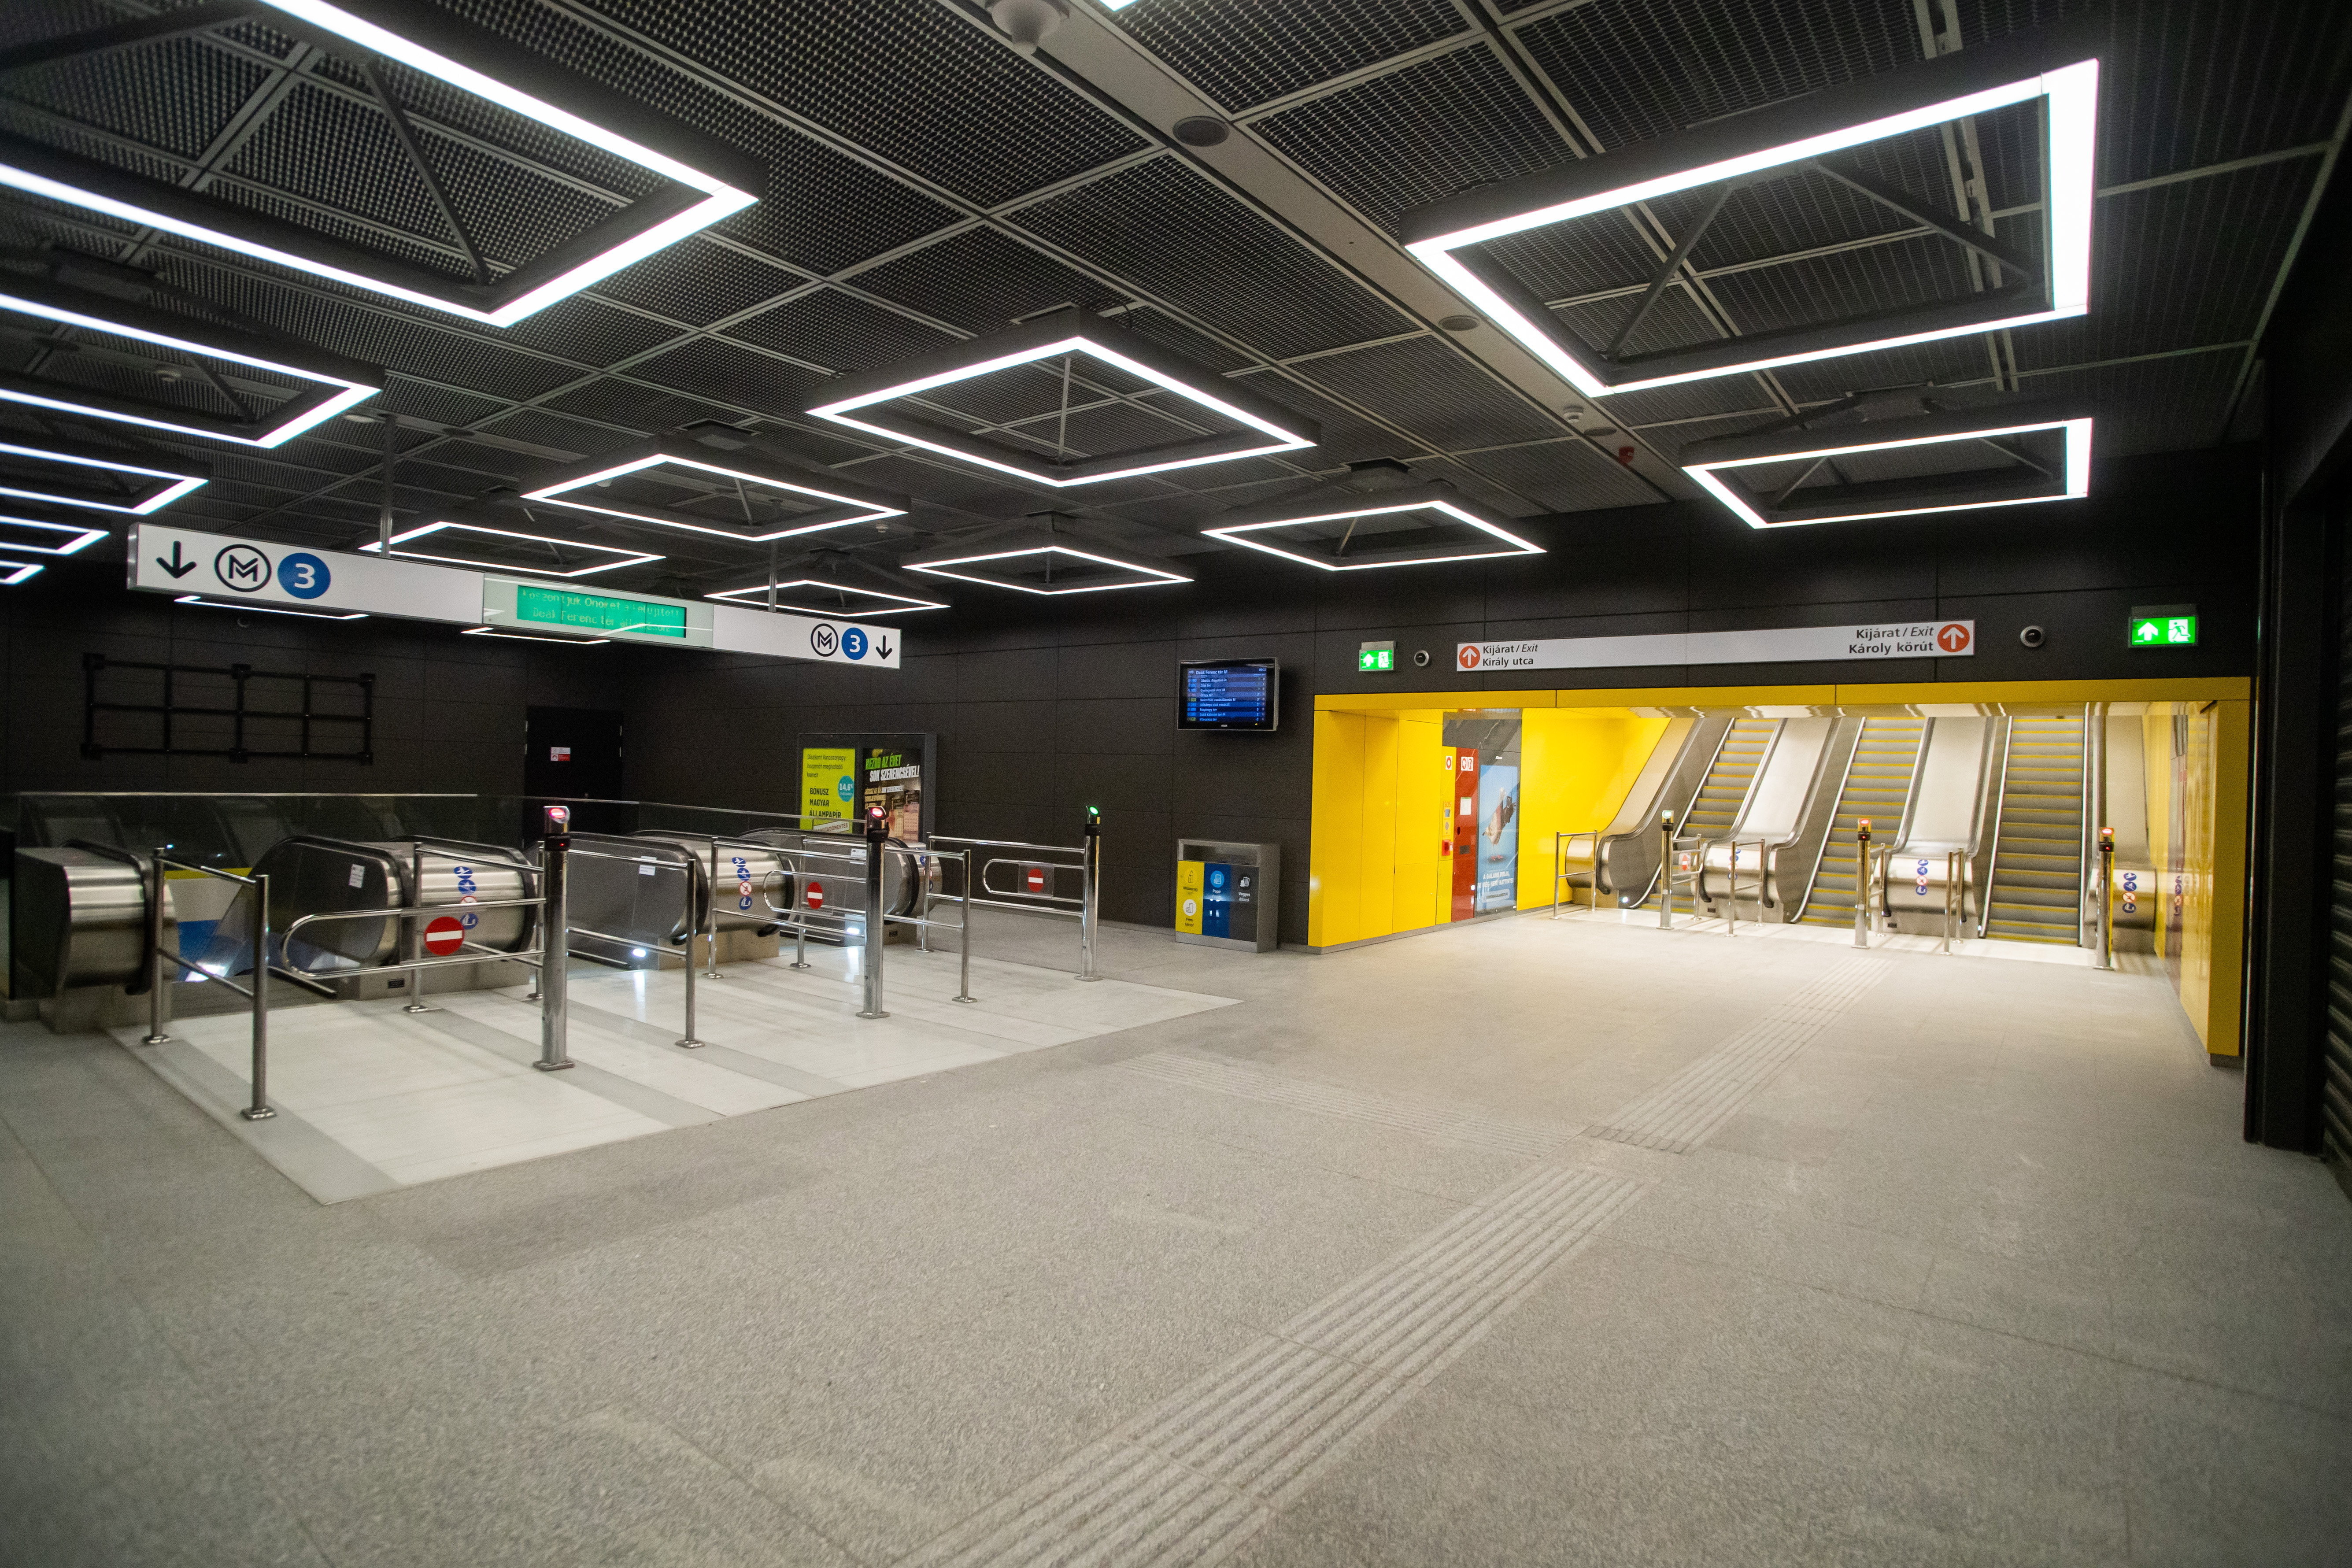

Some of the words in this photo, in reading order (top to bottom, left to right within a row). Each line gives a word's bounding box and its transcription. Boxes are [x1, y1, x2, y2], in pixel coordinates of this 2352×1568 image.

[294, 563, 315, 588] 3
[561, 611, 597, 624] Ferenc
[1856, 627, 1900, 640] Kijárat
[1910, 625, 1934, 637] Exit
[850, 635, 861, 653] 3
[1483, 645, 1514, 655] Kijárat
[1522, 643, 1538, 652] Exit
[1849, 641, 1892, 655] Károly
[1483, 657, 1509, 668] Király
[1513, 657, 1534, 666] utca
[881, 756, 889, 768] AZ
[889, 753, 902, 767] ÉVET
[869, 770, 880, 782] SOK
[880, 764, 920, 781] SZERENCSÉVEL!
[810, 787, 829, 795] BÓNUSZ
[810, 799, 829, 807] MAGYAR
[809, 808, 841, 818] ÁLLAMPAPÍR
